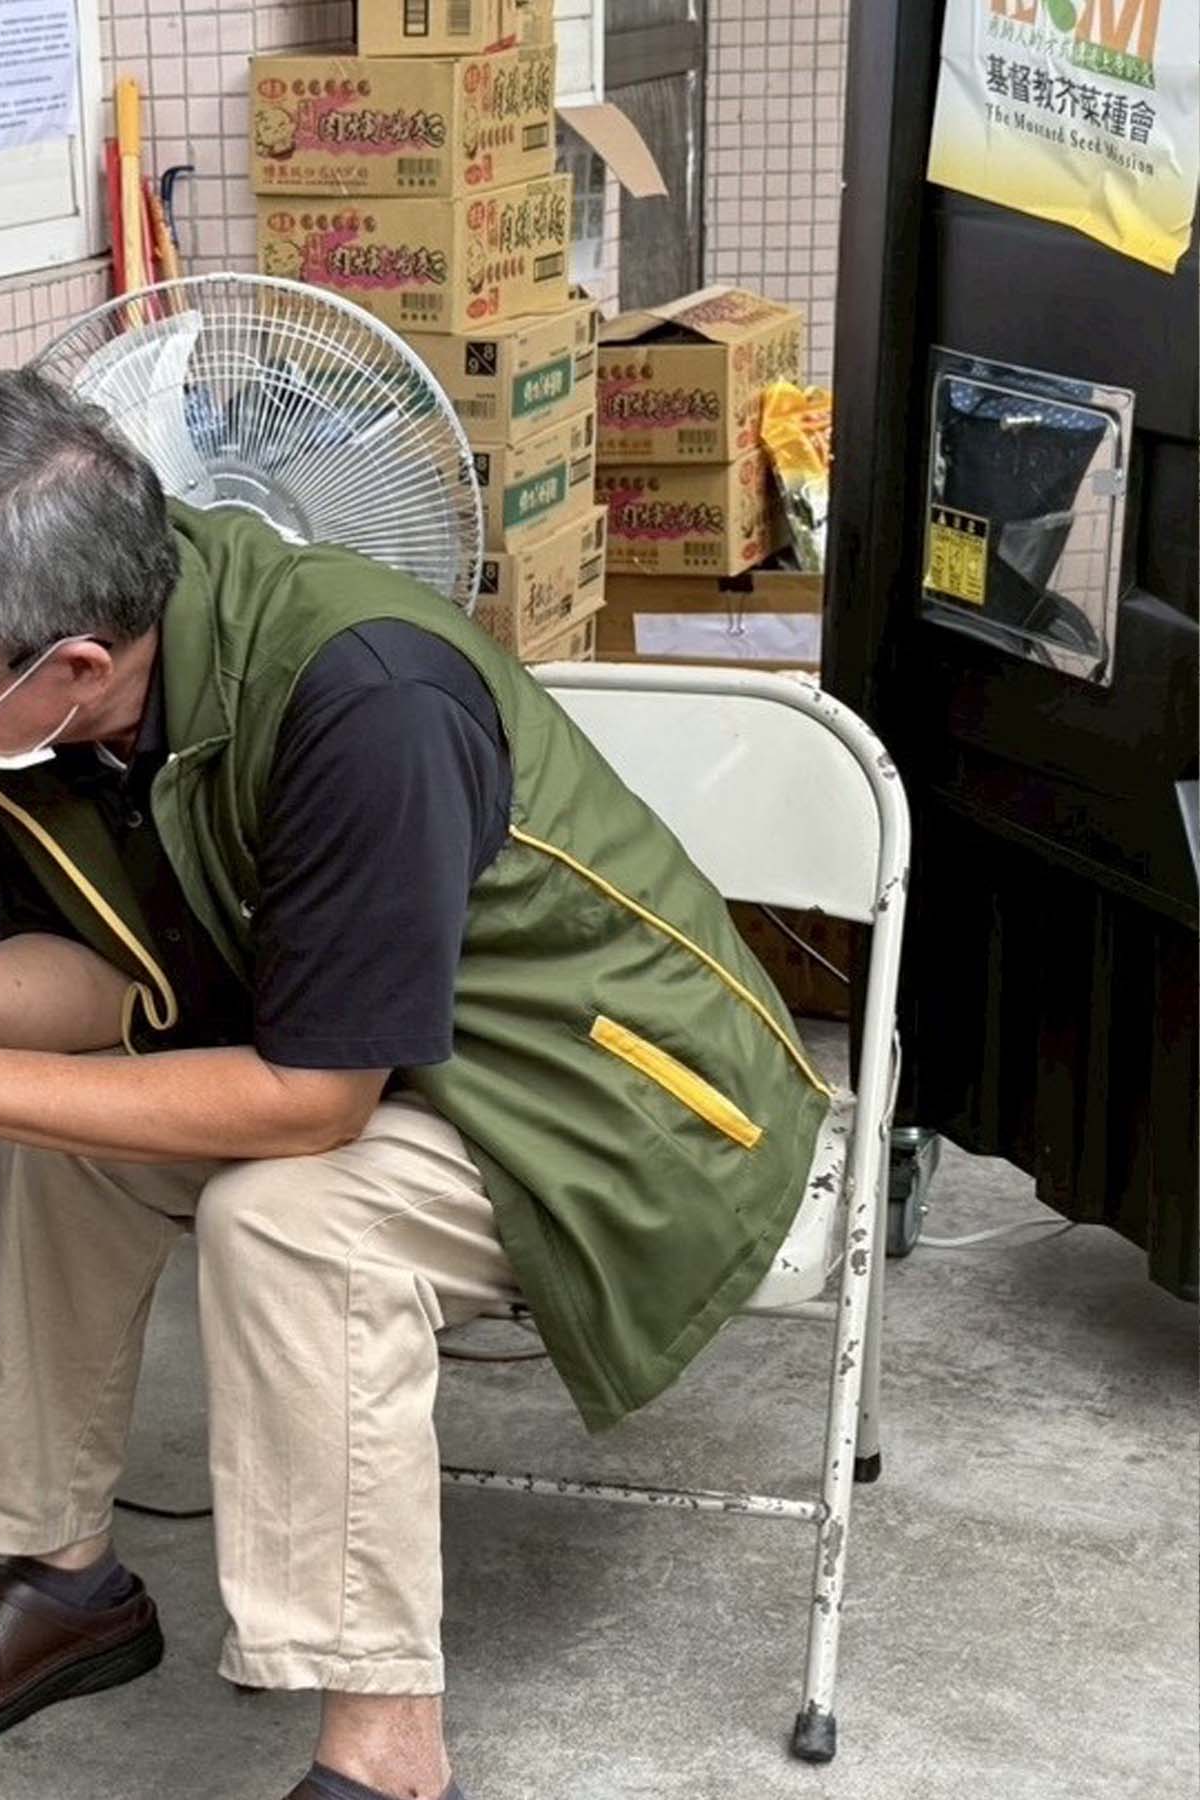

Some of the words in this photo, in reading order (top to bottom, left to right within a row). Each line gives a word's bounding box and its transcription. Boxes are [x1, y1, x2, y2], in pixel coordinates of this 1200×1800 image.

[985, 102, 1010, 126] The
[1014, 112, 1065, 144] Mustard
[1070, 130, 1101, 154] Seed
[1104, 140, 1154, 176] Mission
[986, 53, 1155, 145] 基督教芥菜種會
